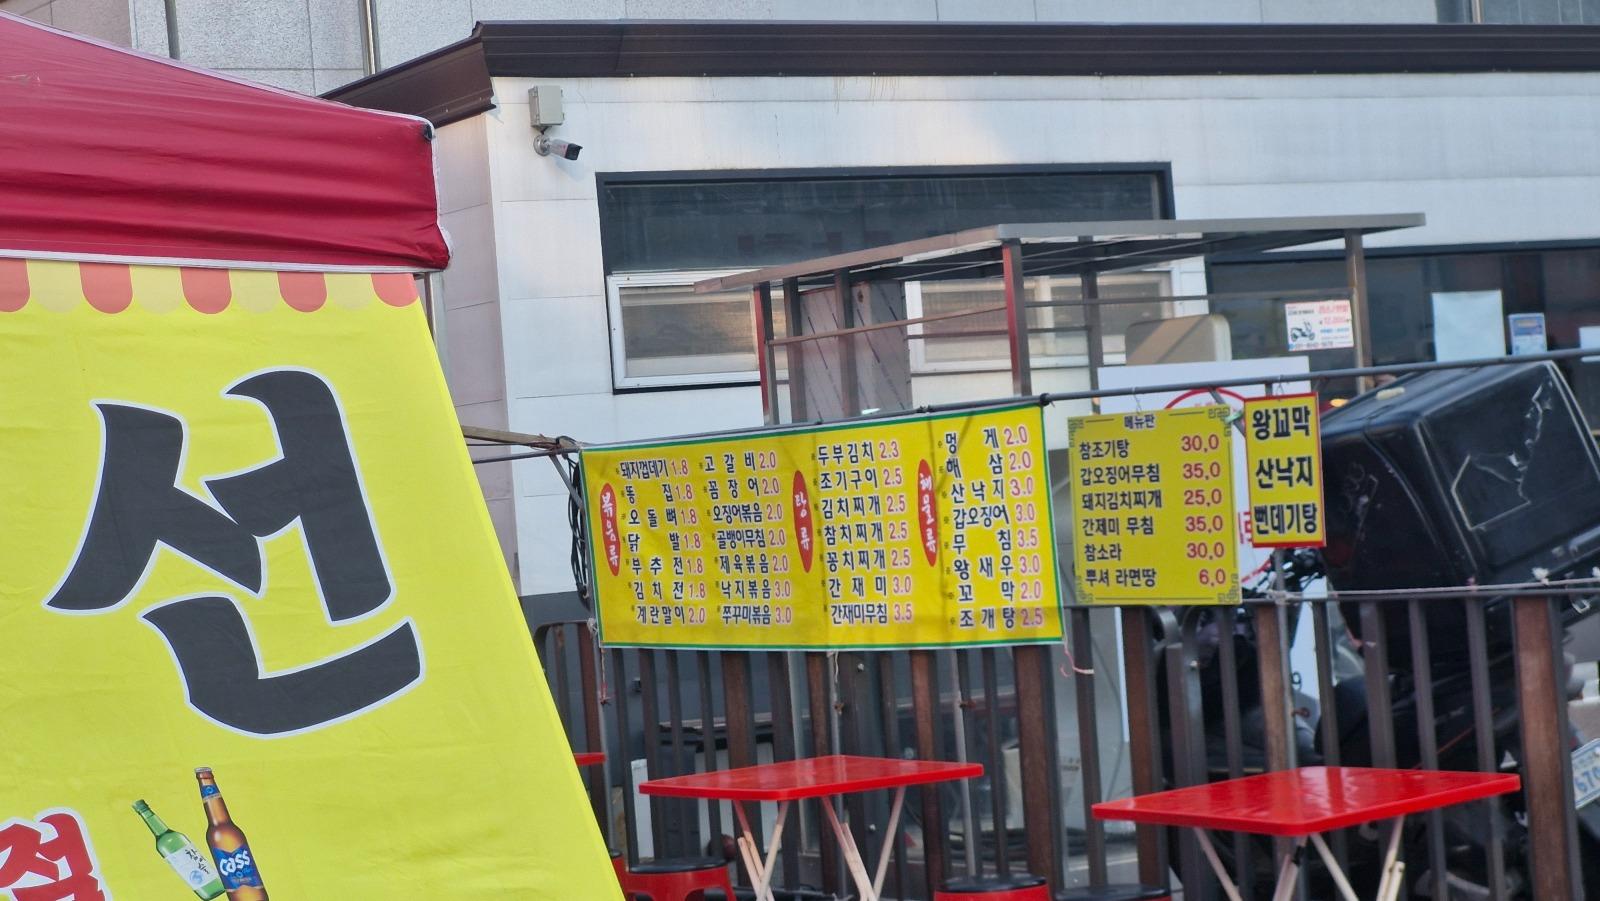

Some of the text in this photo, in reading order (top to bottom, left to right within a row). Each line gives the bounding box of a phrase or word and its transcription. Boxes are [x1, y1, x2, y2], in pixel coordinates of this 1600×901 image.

[1124, 414, 1156, 429] 메뉴판
[1252, 405, 1311, 441] 왕꼬막
[1003, 425, 1028, 446] 2.0
[818, 440, 900, 467] 두부김치 2.3
[1079, 438, 1130, 460] 참조기탕
[672, 459, 689, 476] 1.8
[758, 451, 776, 469] 2.0
[1009, 450, 1032, 471] 2.0
[820, 467, 903, 491] 조기구이 2.5
[1080, 463, 1161, 486] 갑오징어무침
[1255, 456, 1313, 489] 산낙지
[675, 483, 693, 500] 1.8
[762, 477, 780, 495] 2.0
[1009, 476, 1034, 497] 3.0
[821, 494, 907, 520] 김치찌개 2.5
[1082, 489, 1163, 511] 돼지김치찌개
[681, 508, 697, 525] 1.8
[713, 502, 783, 524] 오징어볶음 2.0
[952, 503, 1036, 530] 갑오징어 3.0
[824, 521, 908, 546] 참치찌개 2.5
[1126, 516, 1154, 536] 무침
[684, 533, 701, 549] 1.8
[717, 528, 786, 550] 골뱅이무침 2.0
[1017, 528, 1039, 548] 3.5
[45, 368, 423, 736] 선
[826, 548, 911, 573] 꽁치찌개 2.5
[1084, 543, 1122, 562] 참소라
[687, 558, 703, 574] 1.8
[719, 553, 789, 574] 제육볶음 2.0
[1019, 554, 1040, 574] 3.0
[688, 582, 706, 599] 1.8
[721, 578, 791, 600] 낙지볶음 3.0
[892, 575, 912, 594] 3.0
[1021, 580, 1042, 600] 2.0
[688, 607, 706, 624] 2.0
[775, 607, 792, 624] 3.0
[893, 603, 913, 621] 3.5
[1021, 607, 1043, 626] 2.5
